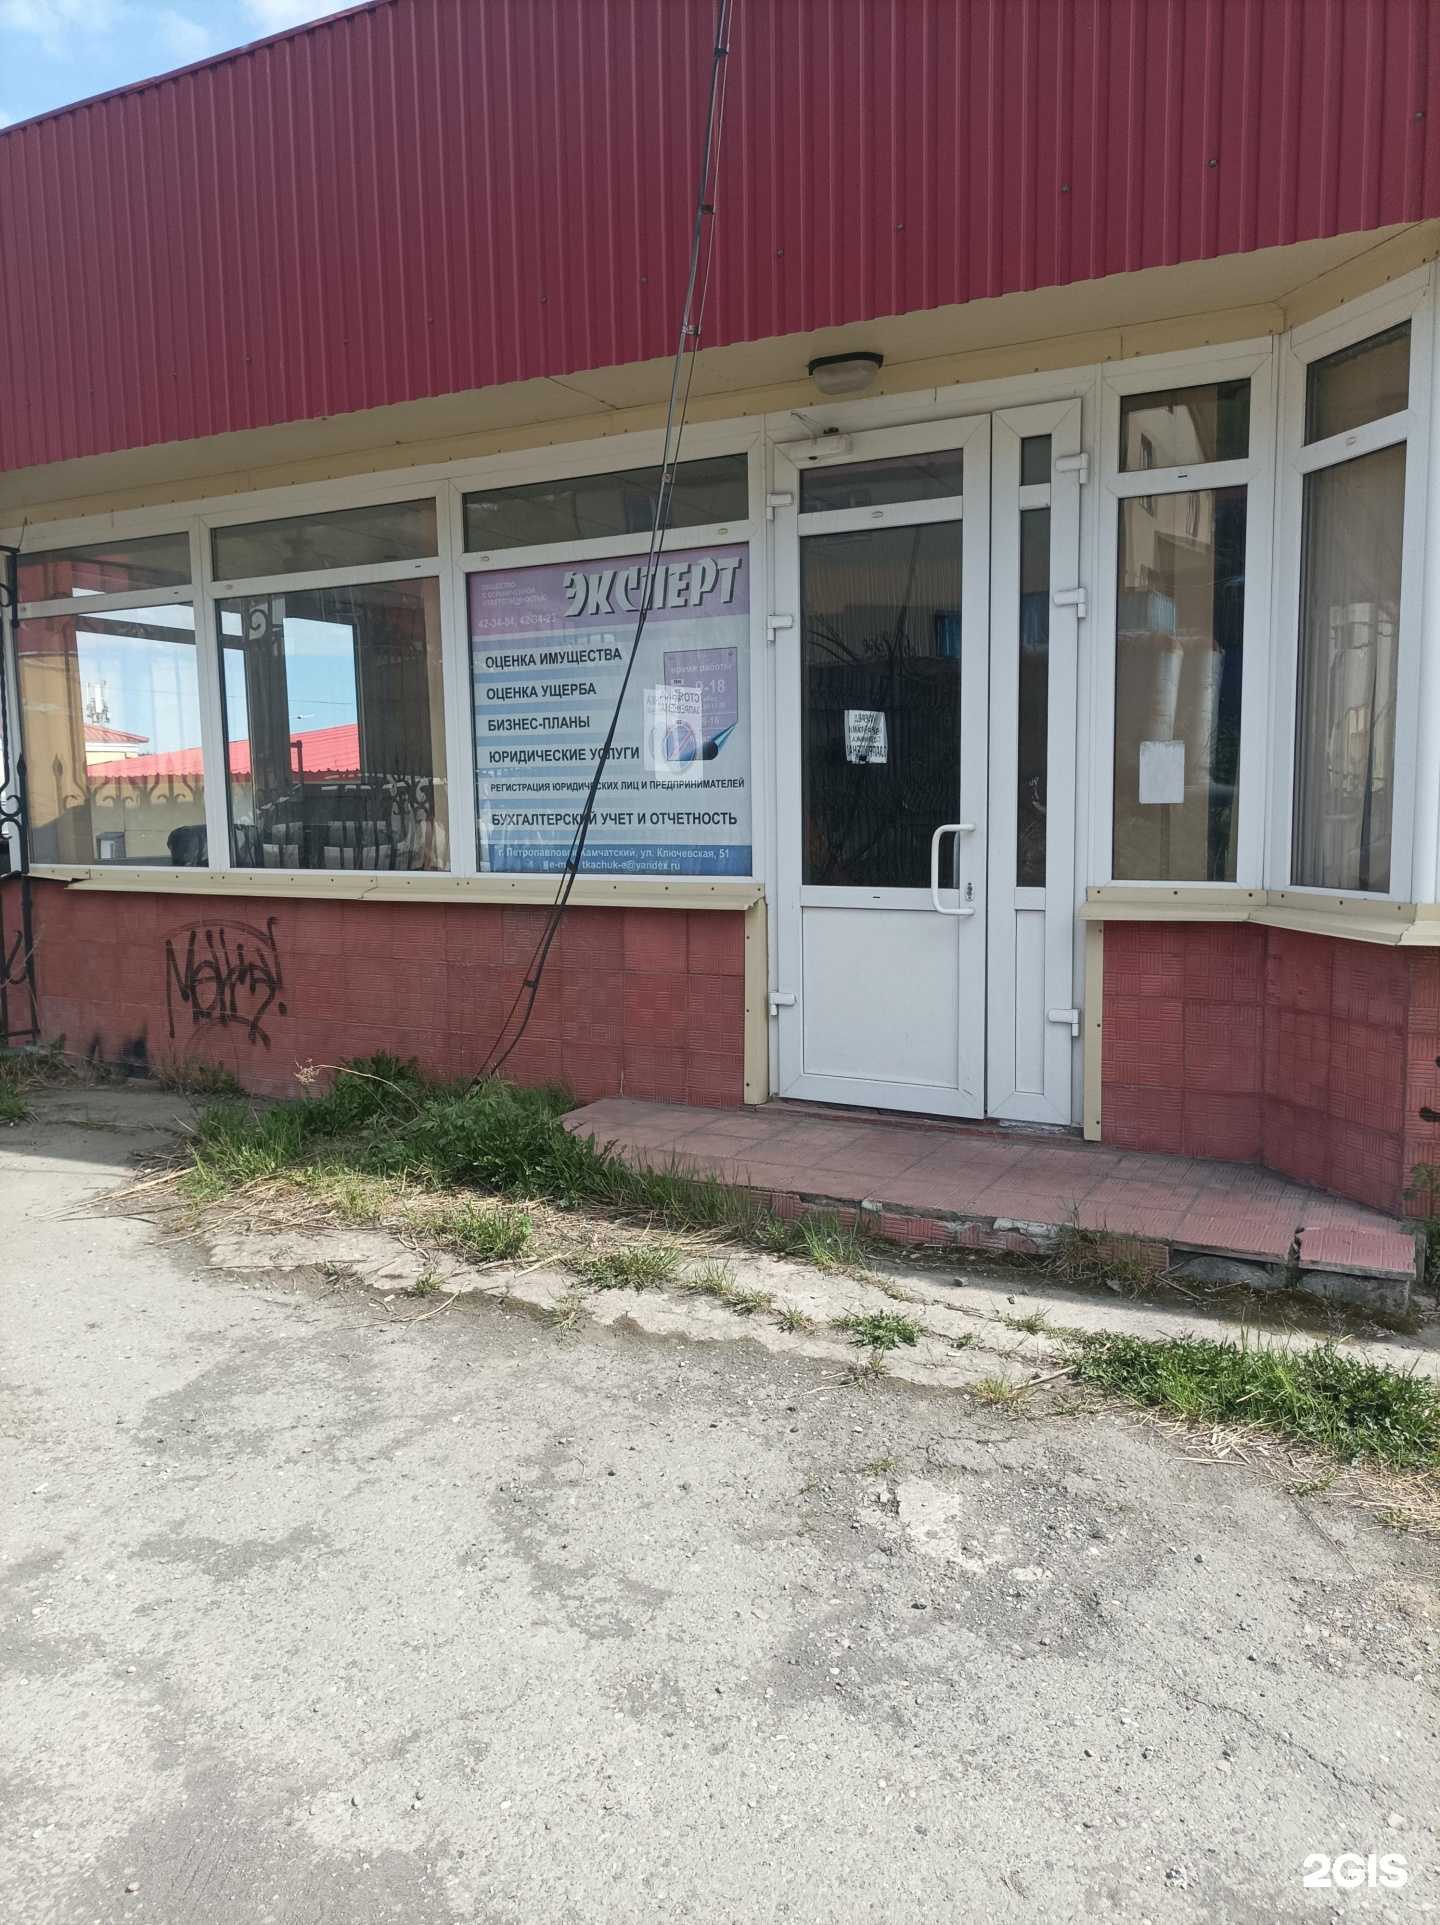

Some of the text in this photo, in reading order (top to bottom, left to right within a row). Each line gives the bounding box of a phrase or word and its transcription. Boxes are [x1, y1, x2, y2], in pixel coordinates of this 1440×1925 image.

[563, 557, 743, 618] ЭКСПЕРТ
[485, 647, 622, 670] ОЦЕНКА ИМУЩЕСТВА
[486, 682, 597, 701] ОЦЕНКА УЩЕРБА
[488, 716, 590, 731] БИЗНЕС-ПЛАНЫ
[489, 749, 586, 764] ЮРИДИЧЕСКИЕ
[490, 777, 745, 792] РЕГИСТРАЦИЯ ЮРИДИЧСКИХ ЛИЦ И ПРЕДПРИНИМАТЕЛЕЙ
[601, 813, 633, 825] УЧЕТ
[637, 813, 646, 824] И
[650, 812, 738, 825] ОТЧЕТНОСТЬ
[719, 848, 730, 858] 51
